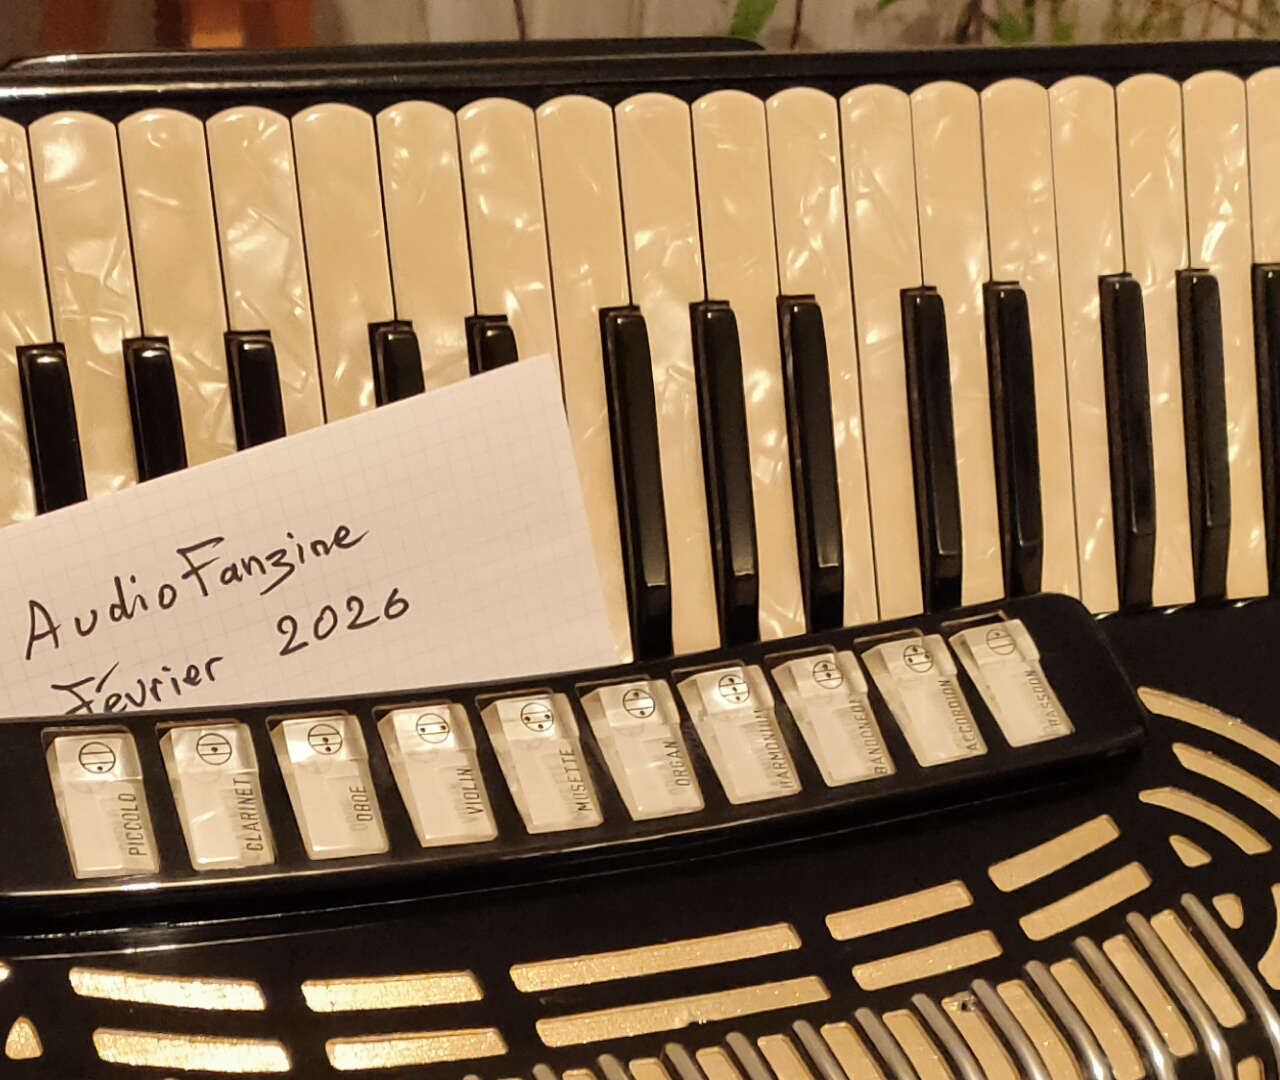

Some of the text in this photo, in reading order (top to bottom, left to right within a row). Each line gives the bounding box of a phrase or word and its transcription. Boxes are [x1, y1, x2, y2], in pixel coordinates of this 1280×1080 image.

[26, 522, 370, 660] AudioFanzine
[51, 587, 410, 715] Février 2026
[754, 709, 794, 789] HARMONIUM
[938, 680, 979, 751] ACCORDION
[456, 768, 485, 815] VIOLIN
[559, 748, 593, 812] MUSETTE
[663, 741, 691, 787] ORGAN
[118, 792, 148, 856] PICCOLO
[233, 778, 265, 852] CLARINET
[349, 786, 373, 822] OBOE
